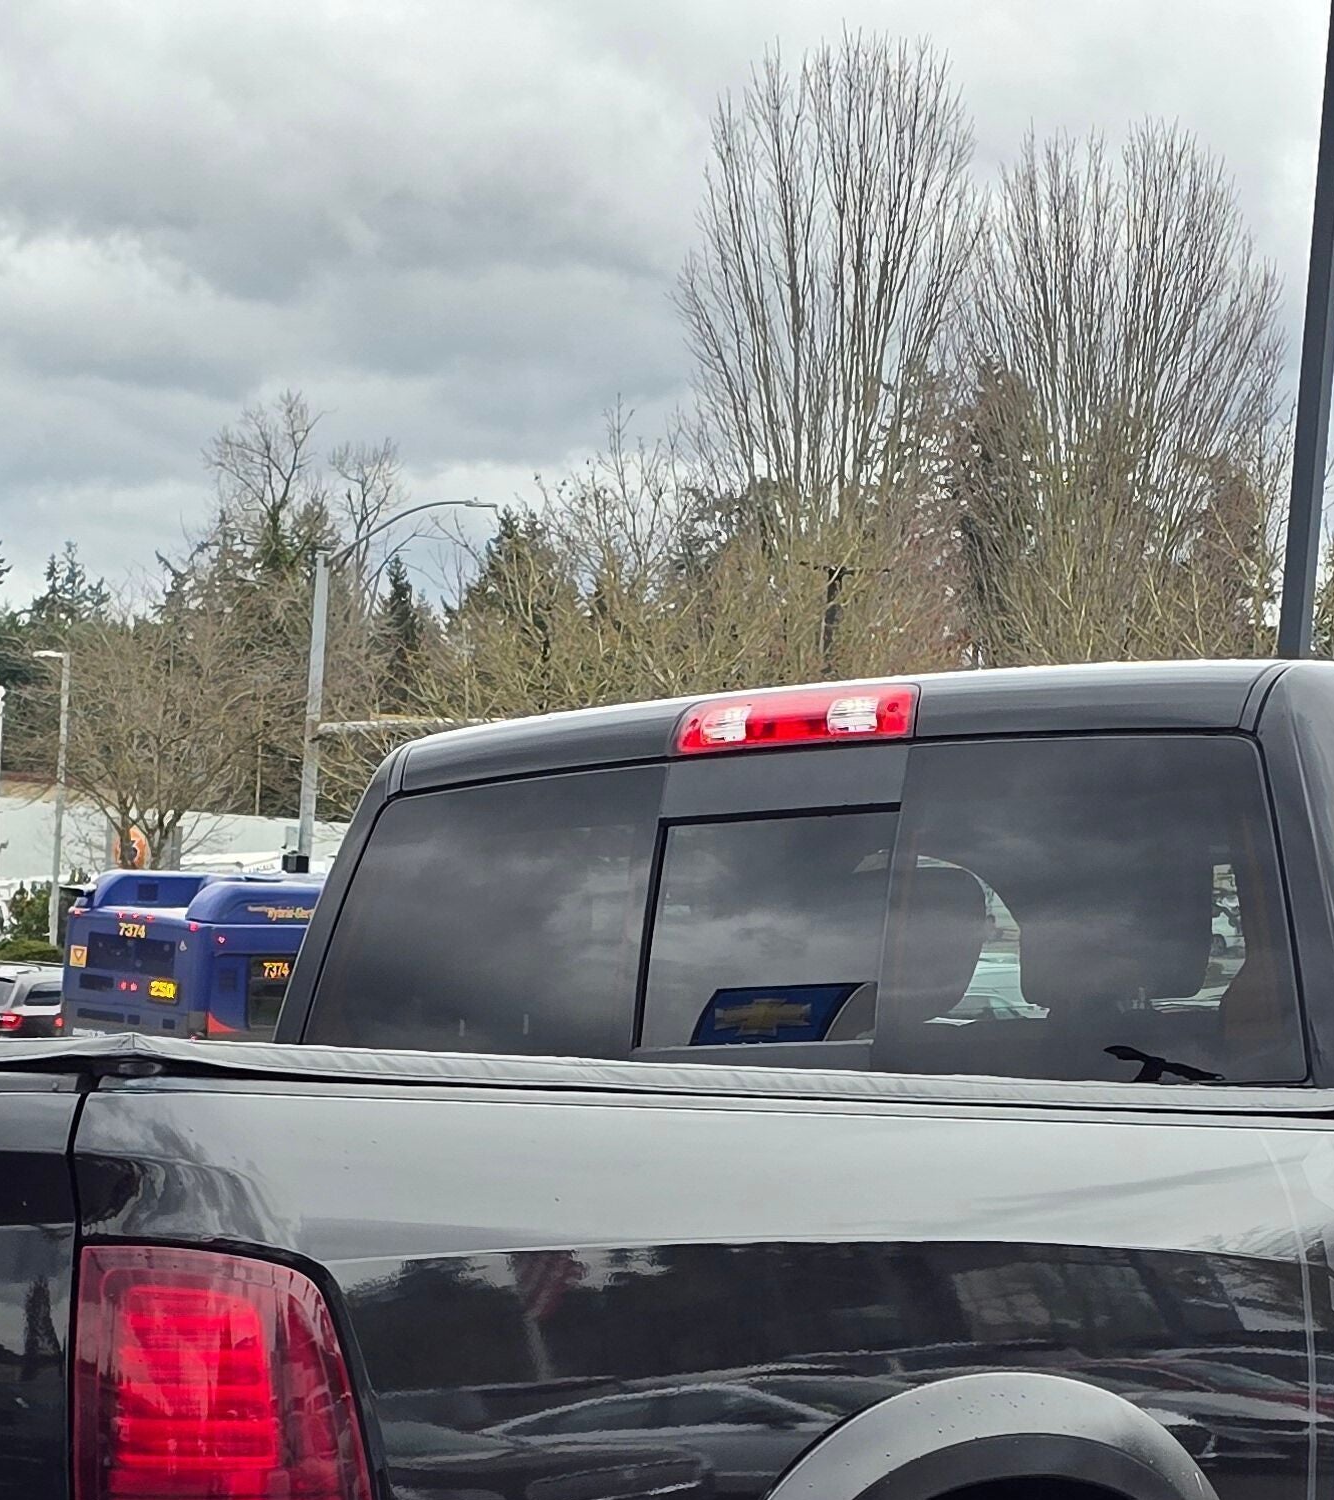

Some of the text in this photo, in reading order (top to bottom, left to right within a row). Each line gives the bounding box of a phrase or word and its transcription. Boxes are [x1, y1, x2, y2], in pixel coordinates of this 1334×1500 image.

[119, 923, 146, 939] 7374
[263, 962, 290, 979] 7374
[150, 980, 175, 998] 250
